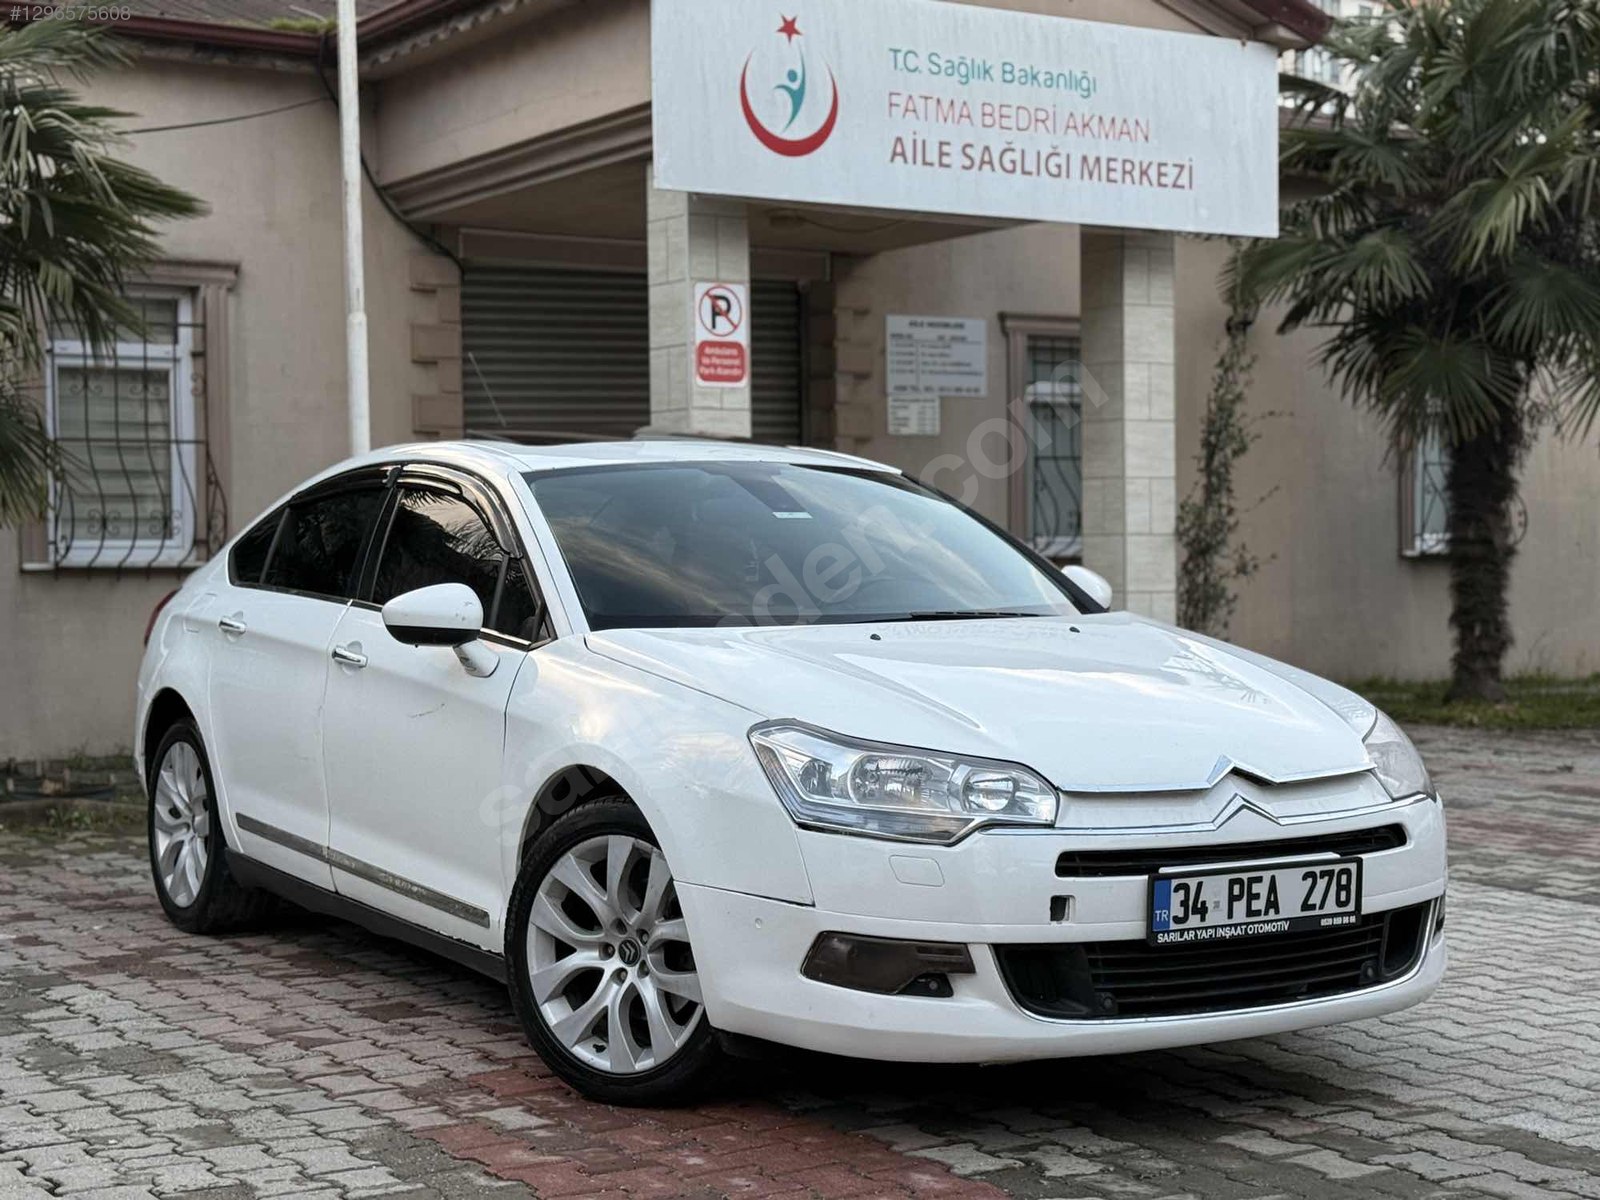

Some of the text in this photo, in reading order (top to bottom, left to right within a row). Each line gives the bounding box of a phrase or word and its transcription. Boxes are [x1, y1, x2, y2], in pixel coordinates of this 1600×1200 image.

[927, 52, 995, 85] Sağlık
[1001, 61, 1097, 99] Bakanlığı
[888, 91, 1149, 143] FATMA BEDRİ AKMAN
[889, 131, 1194, 190] AİLE SAĞLIĞI MERKEZİ
[1154, 909, 1169, 923] TR
[1172, 867, 1353, 925] 34 PEA 278
[1157, 929, 1195, 943] SARILAR
[1196, 927, 1215, 940] YAPI
